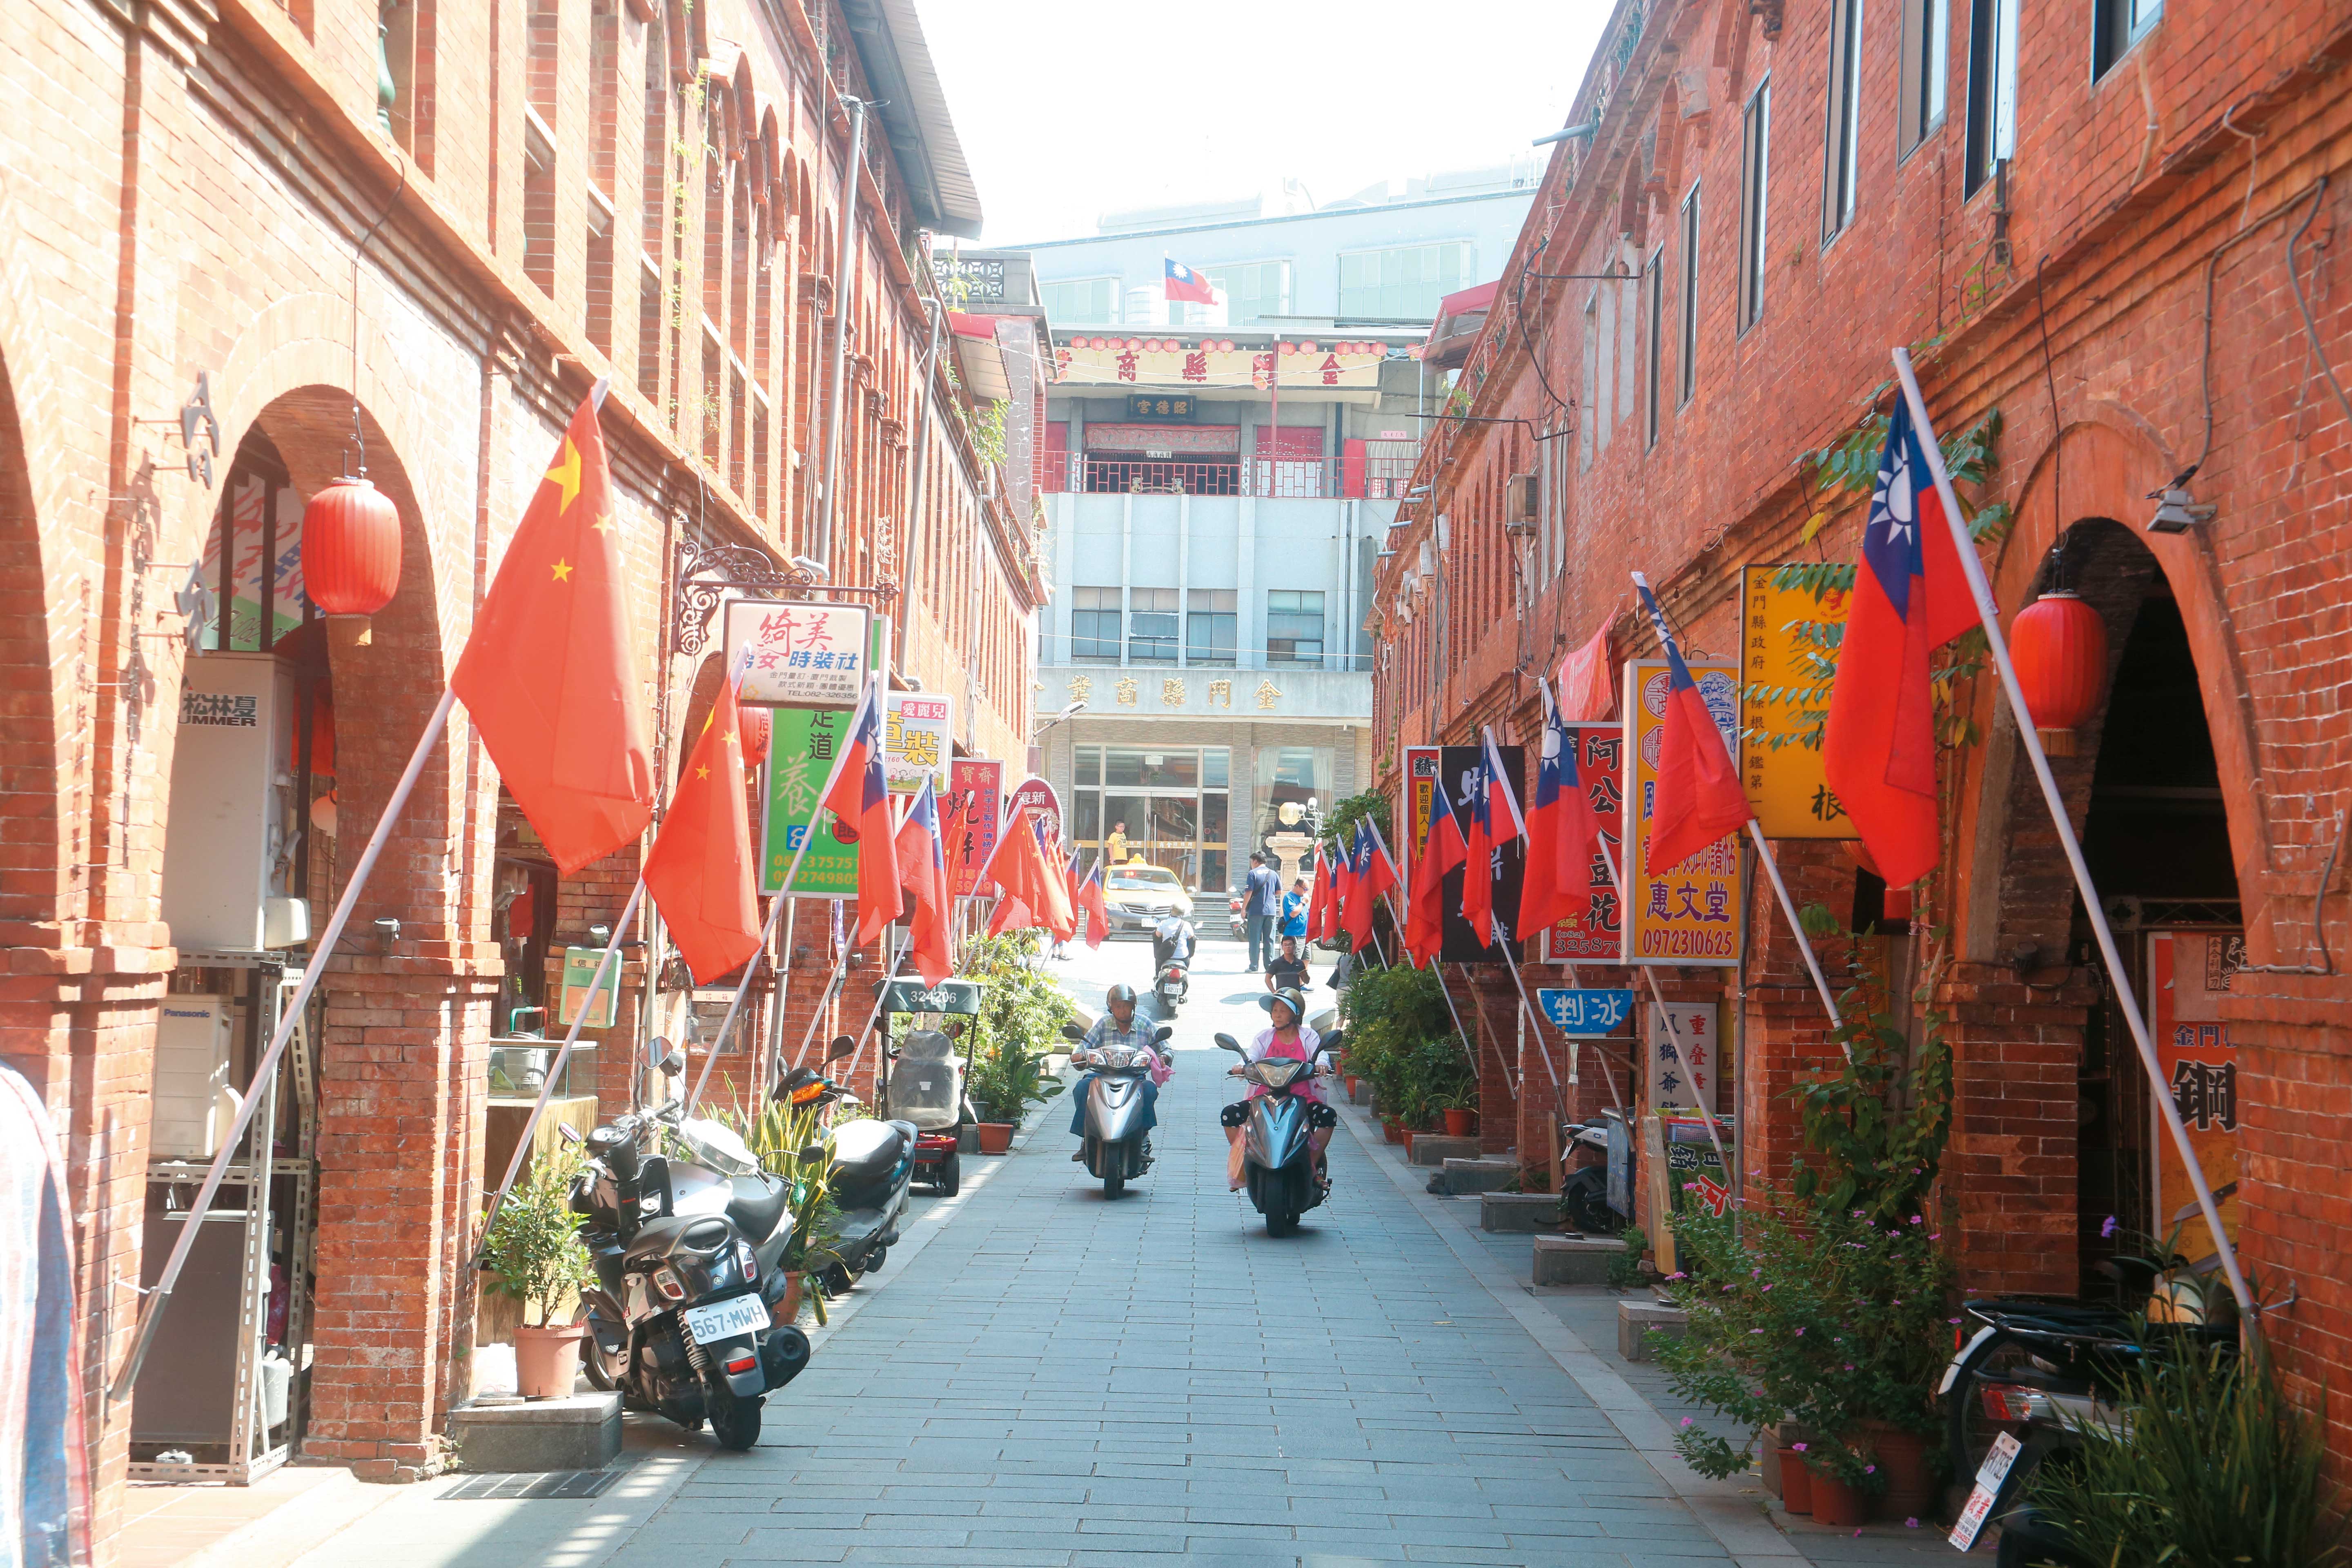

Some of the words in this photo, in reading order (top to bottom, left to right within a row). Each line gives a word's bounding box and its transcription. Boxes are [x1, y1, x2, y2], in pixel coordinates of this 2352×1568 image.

[1037, 675, 1283, 709] 金門縣商業
[183, 693, 256, 717] 松林夏
[903, 702, 944, 718] 愛麗兒
[951, 766, 995, 785] 寶齋
[1646, 880, 1730, 922] 惠文堂
[1556, 930, 1585, 939] (082)
[1643, 929, 1733, 956] 0972310625
[910, 990, 956, 1004] 324206
[164, 1009, 210, 1018] Panasonic
[1554, 994, 1622, 1025] 剉冰
[2172, 1060, 2236, 1132] 鋼
